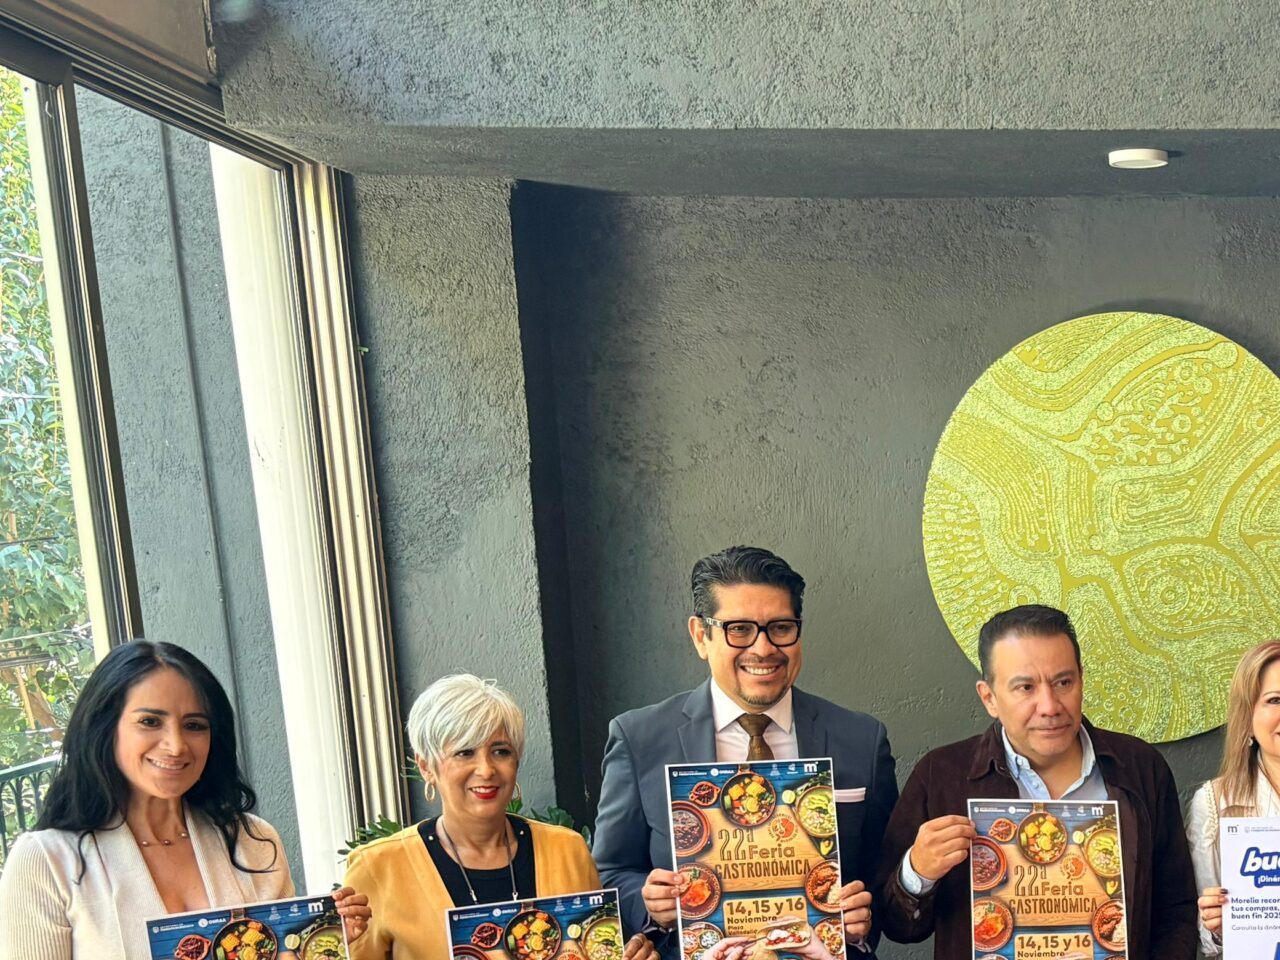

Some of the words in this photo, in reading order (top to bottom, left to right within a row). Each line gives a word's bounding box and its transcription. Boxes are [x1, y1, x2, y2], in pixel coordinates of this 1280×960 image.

[748, 844, 794, 859] Feria
[715, 859, 810, 880] GASTRONÓMICA
[1040, 882, 1083, 895] Feria
[774, 902, 783, 915] y
[786, 897, 804, 911] 16
[1009, 896, 1097, 914] GASTRONÓMICA
[727, 915, 777, 924] Noviembre
[1062, 938, 1071, 951] y
[1073, 935, 1090, 947] 16
[1017, 949, 1065, 957] Noviembre
